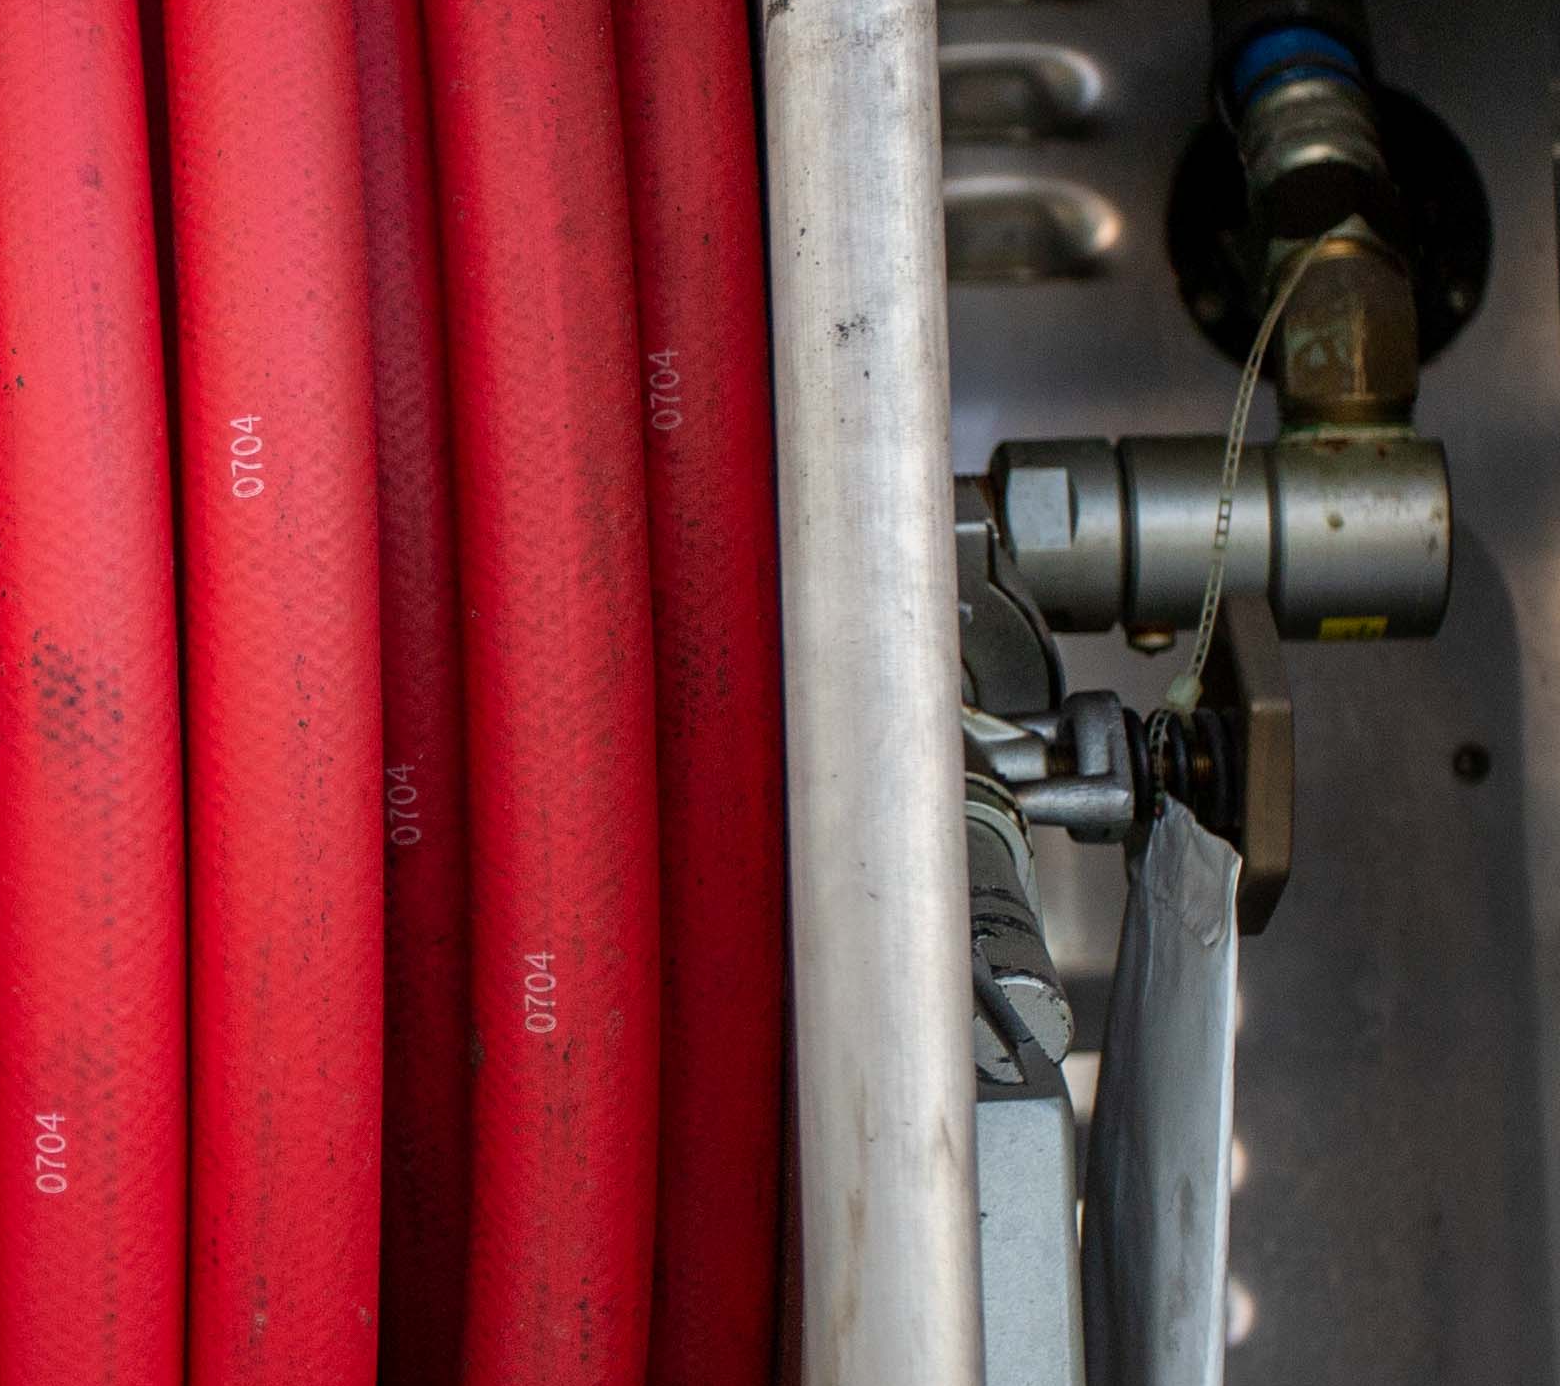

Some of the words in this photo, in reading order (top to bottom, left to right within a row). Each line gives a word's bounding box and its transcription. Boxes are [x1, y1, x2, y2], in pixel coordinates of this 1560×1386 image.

[647, 347, 685, 432] 0704
[231, 413, 265, 499] 0704
[386, 761, 422, 847] 0704
[524, 949, 558, 1035] 0704
[35, 1110, 69, 1195] 0704
